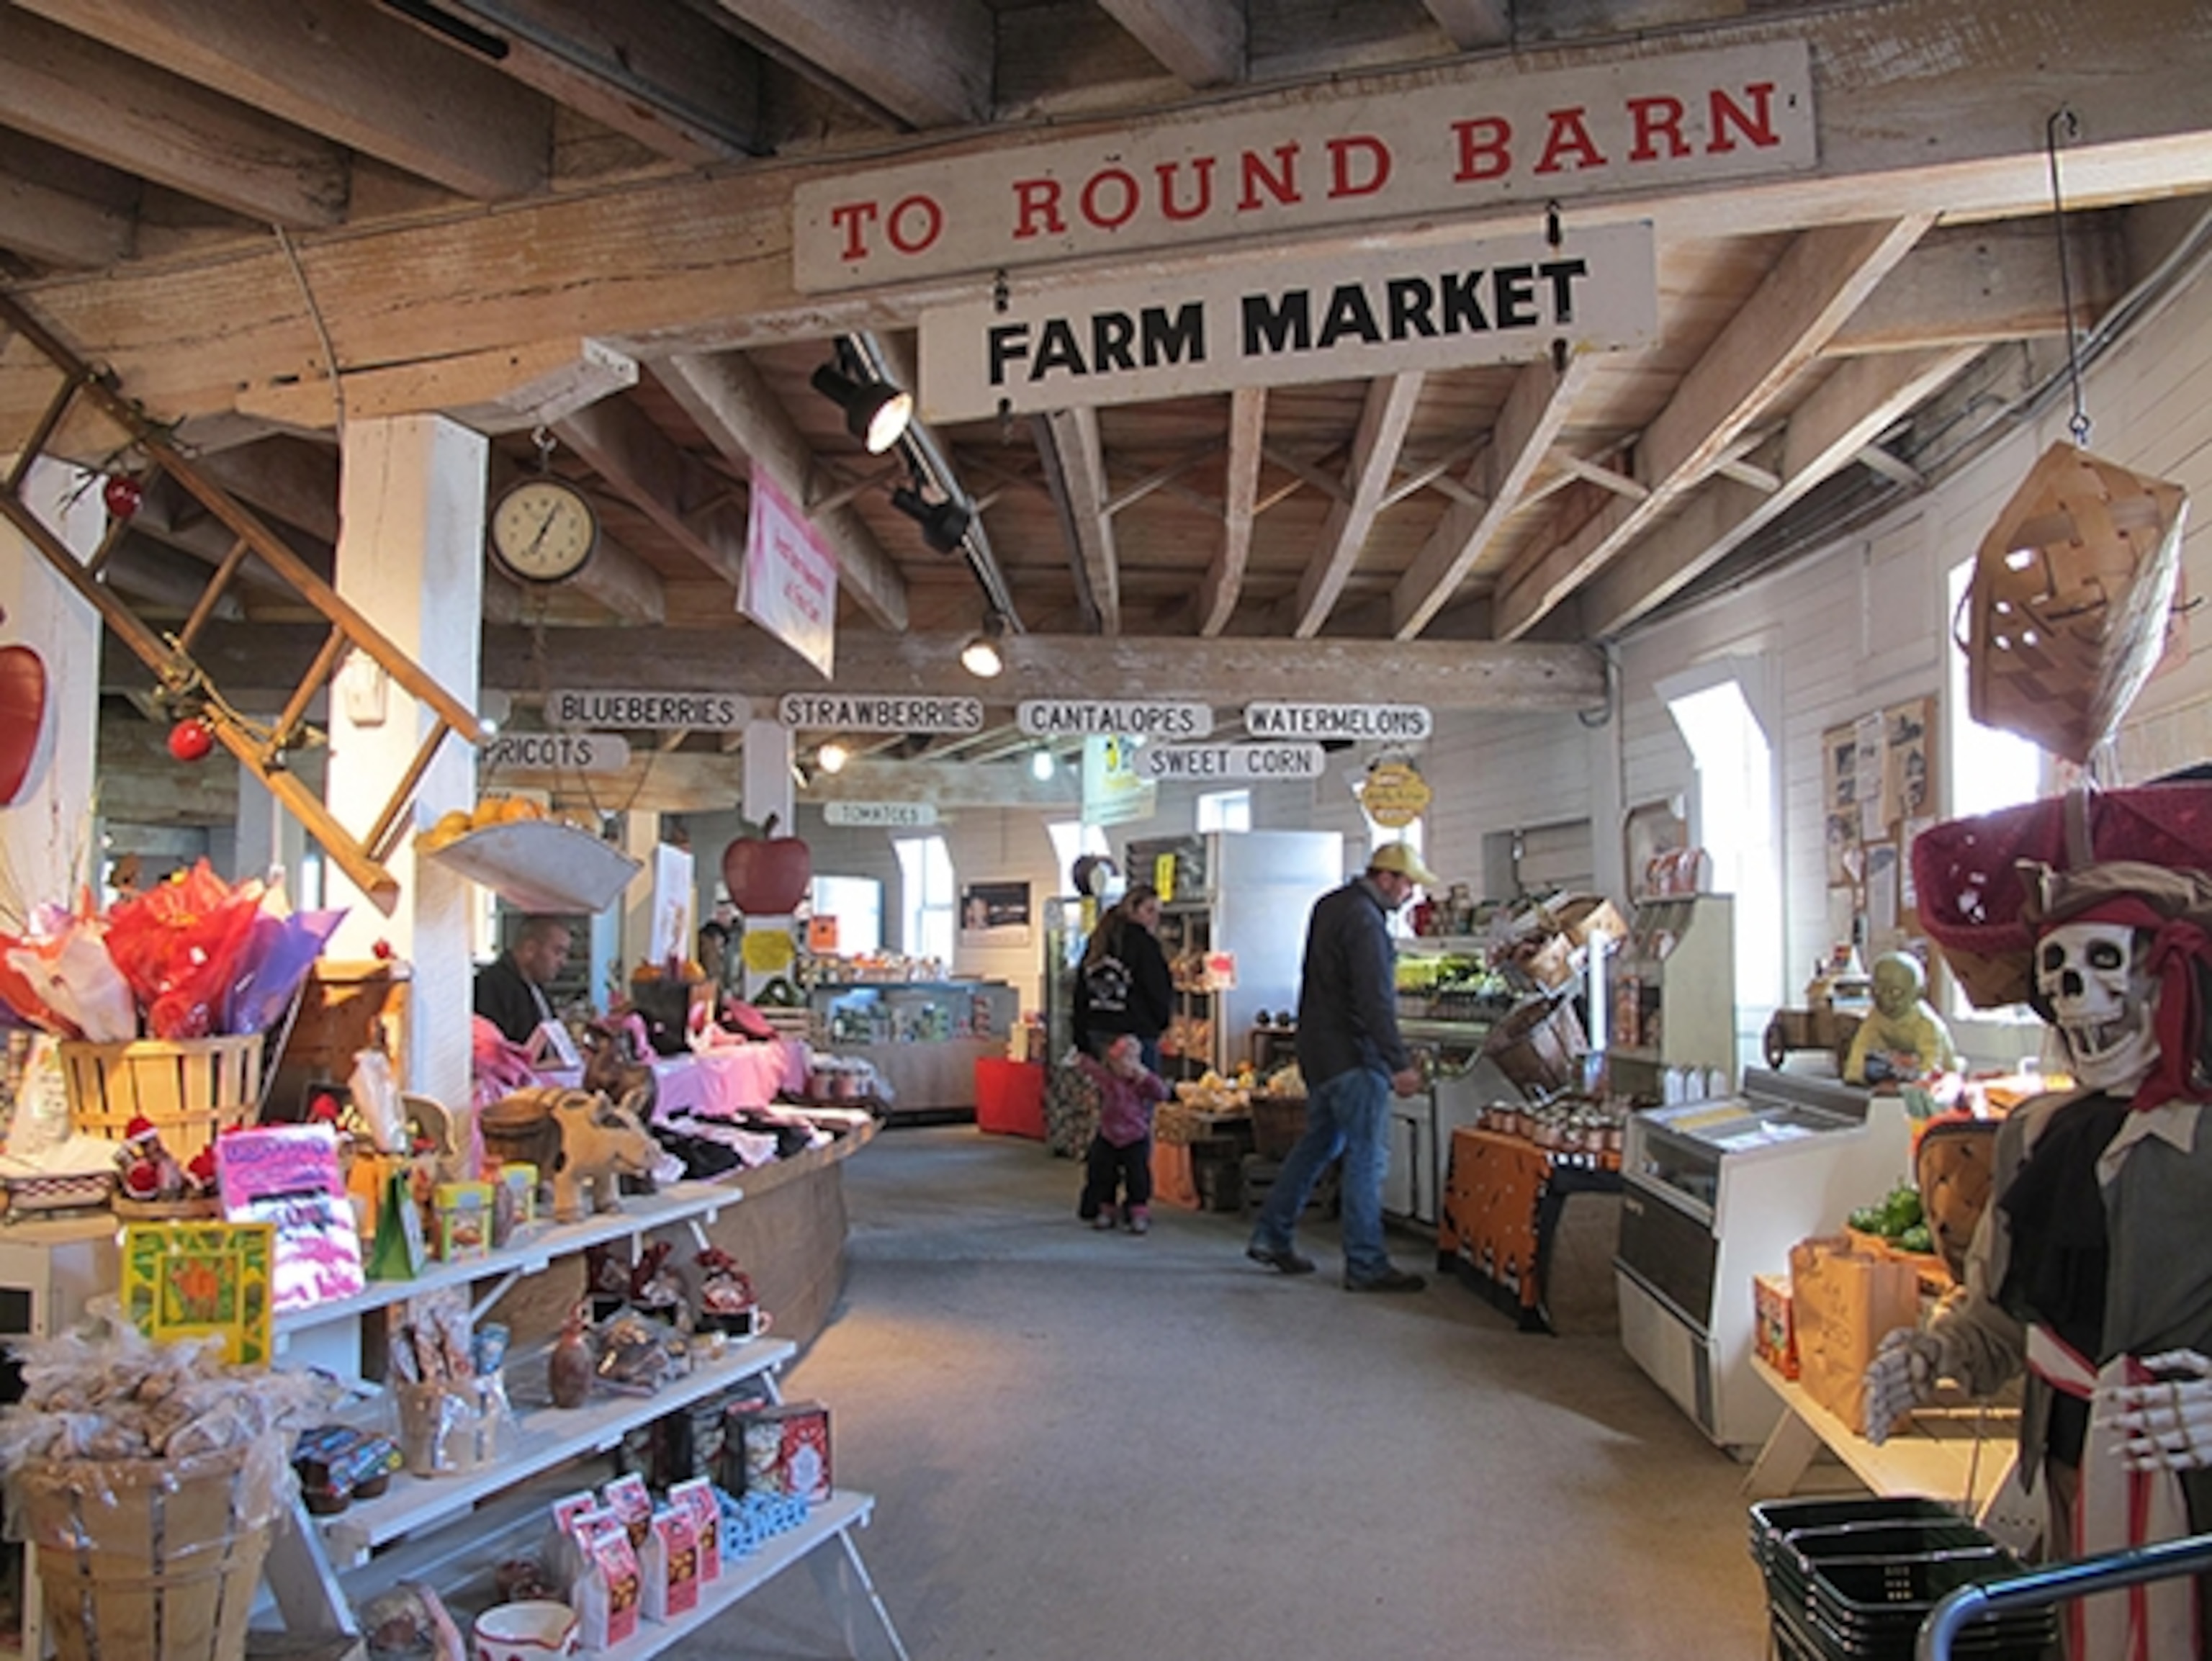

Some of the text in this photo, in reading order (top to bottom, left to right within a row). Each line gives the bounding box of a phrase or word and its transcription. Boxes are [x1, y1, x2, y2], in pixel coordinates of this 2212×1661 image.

[831, 82, 1780, 261] TO ROUND BARN
[988, 258, 1587, 386] FARM MARKET
[561, 695, 735, 725] BLUEBERRIES
[786, 698, 978, 729] STRAWBERRIES
[1031, 704, 1195, 733] CANTALOPES
[1252, 708, 1425, 736] WATERMELONS
[483, 738, 593, 766] PRICOTS
[1151, 750, 1228, 775] SWEET
[1249, 749, 1312, 774] CORN
